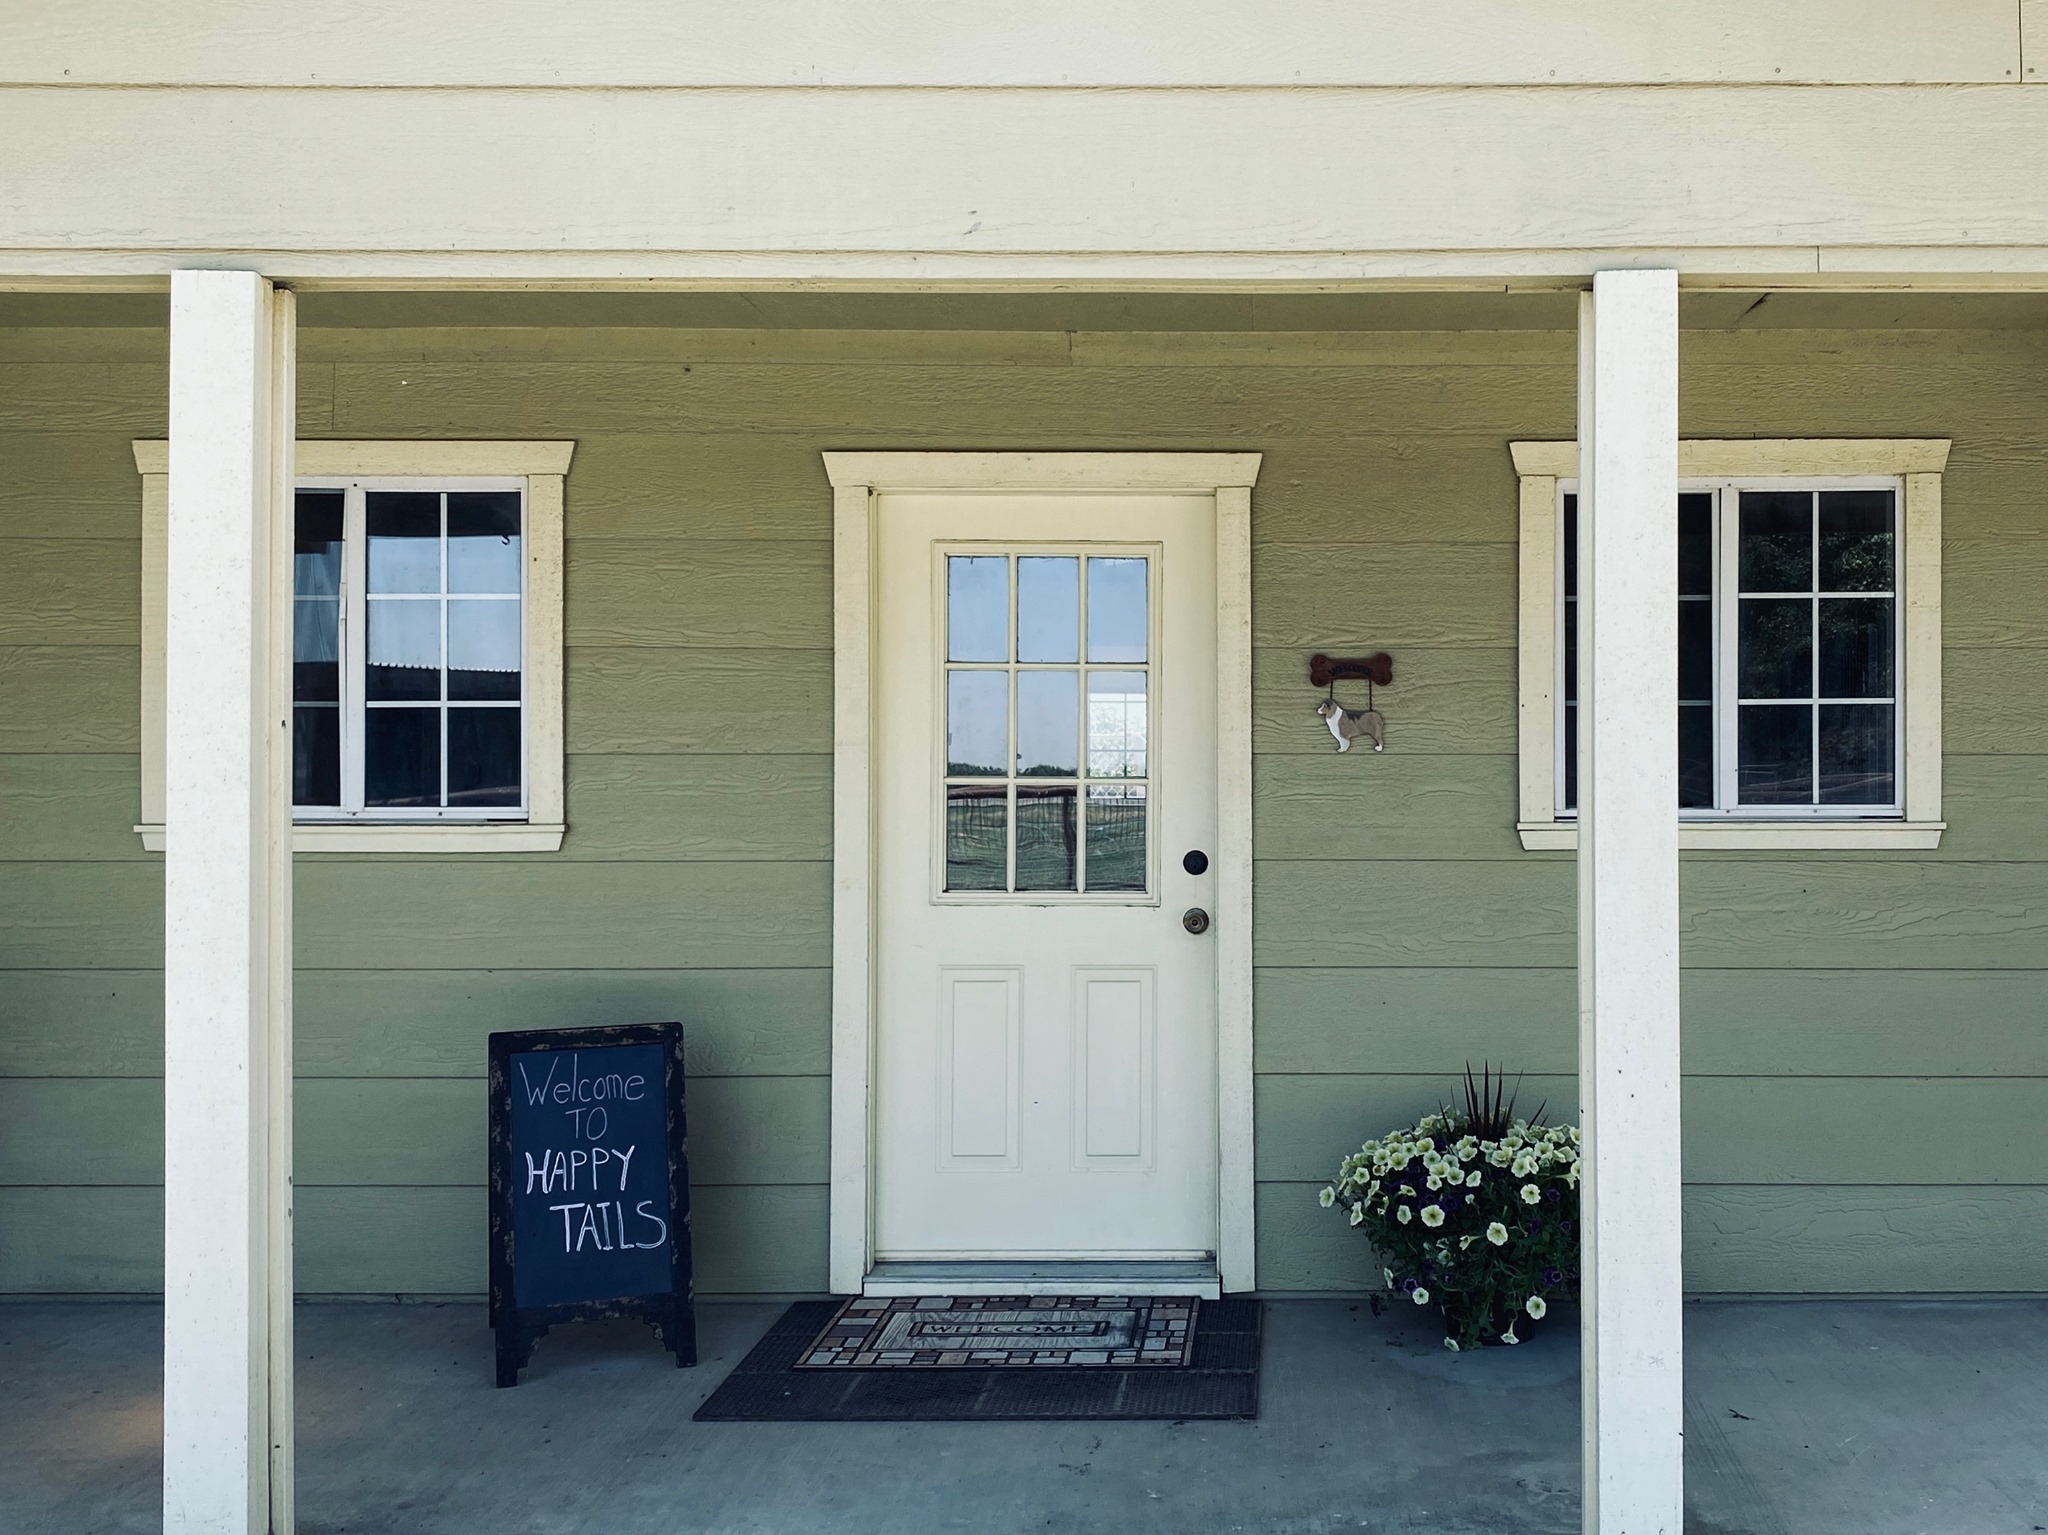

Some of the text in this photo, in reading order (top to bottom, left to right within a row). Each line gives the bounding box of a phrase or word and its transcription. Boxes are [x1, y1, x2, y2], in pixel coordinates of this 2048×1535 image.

[519, 1052, 645, 1106] Welcome
[565, 1106, 608, 1141] TO
[525, 1145, 636, 1195] HAPPY
[549, 1200, 667, 1253] TAILS
